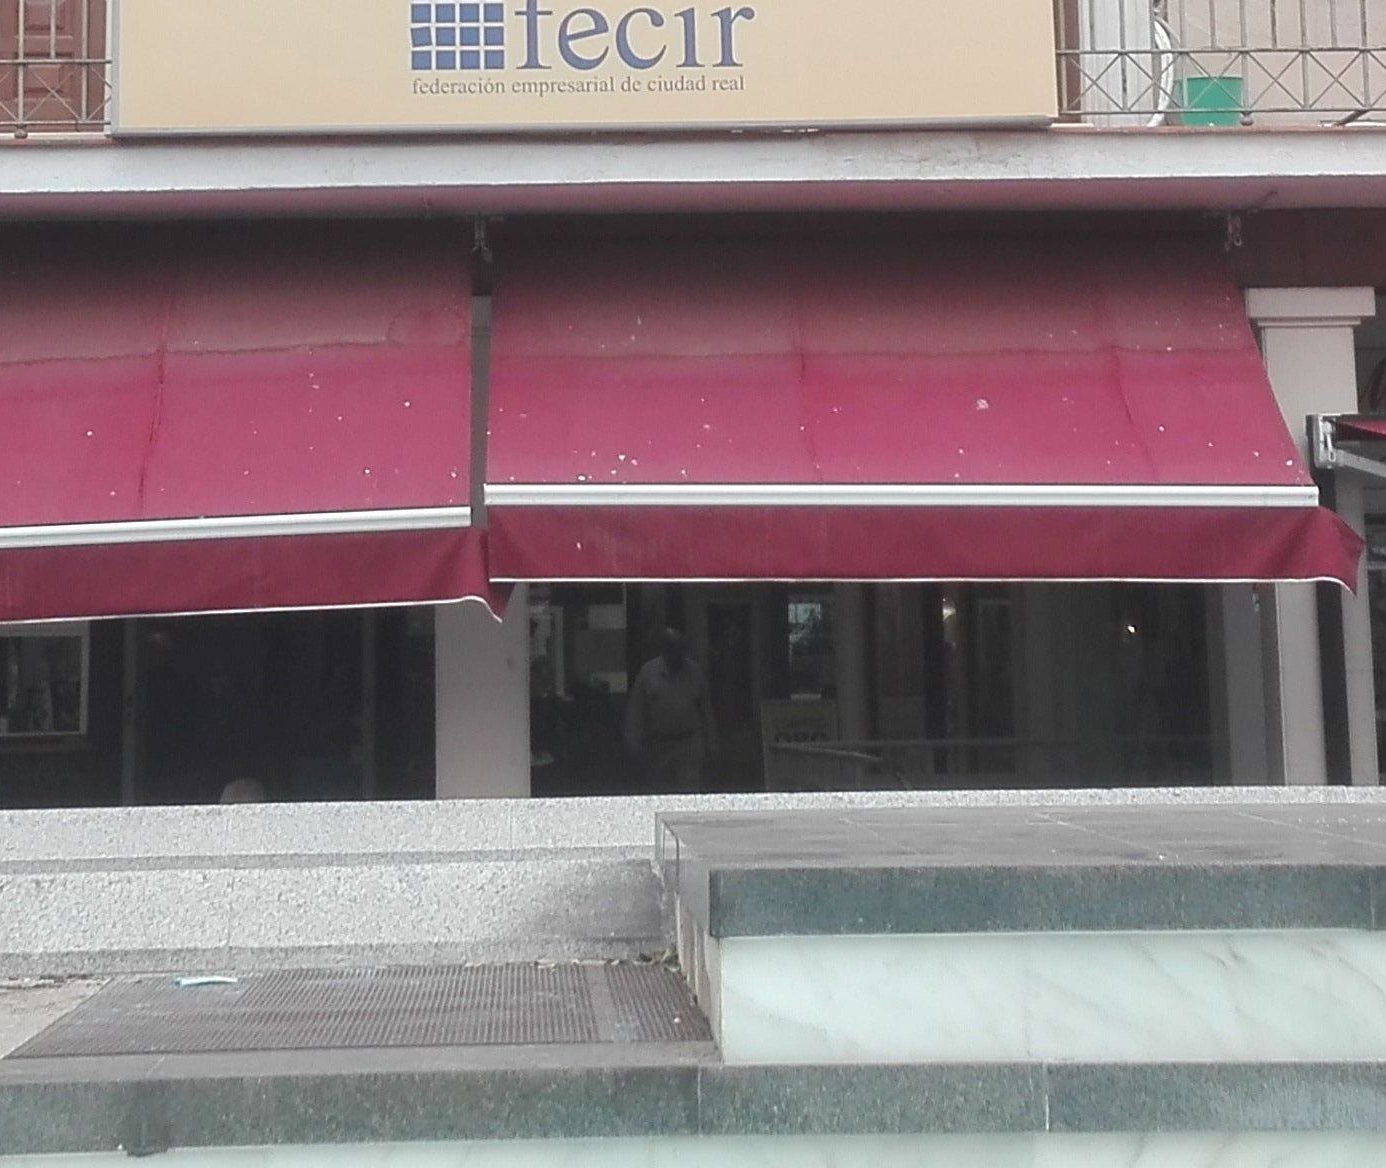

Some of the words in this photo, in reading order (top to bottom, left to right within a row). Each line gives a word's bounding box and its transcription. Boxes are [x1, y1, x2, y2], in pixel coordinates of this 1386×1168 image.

[412, 77, 506, 95] federación
[512, 76, 615, 97] empresarial
[620, 75, 642, 93] de
[647, 75, 706, 92] ciudad
[712, 75, 745, 91] real
